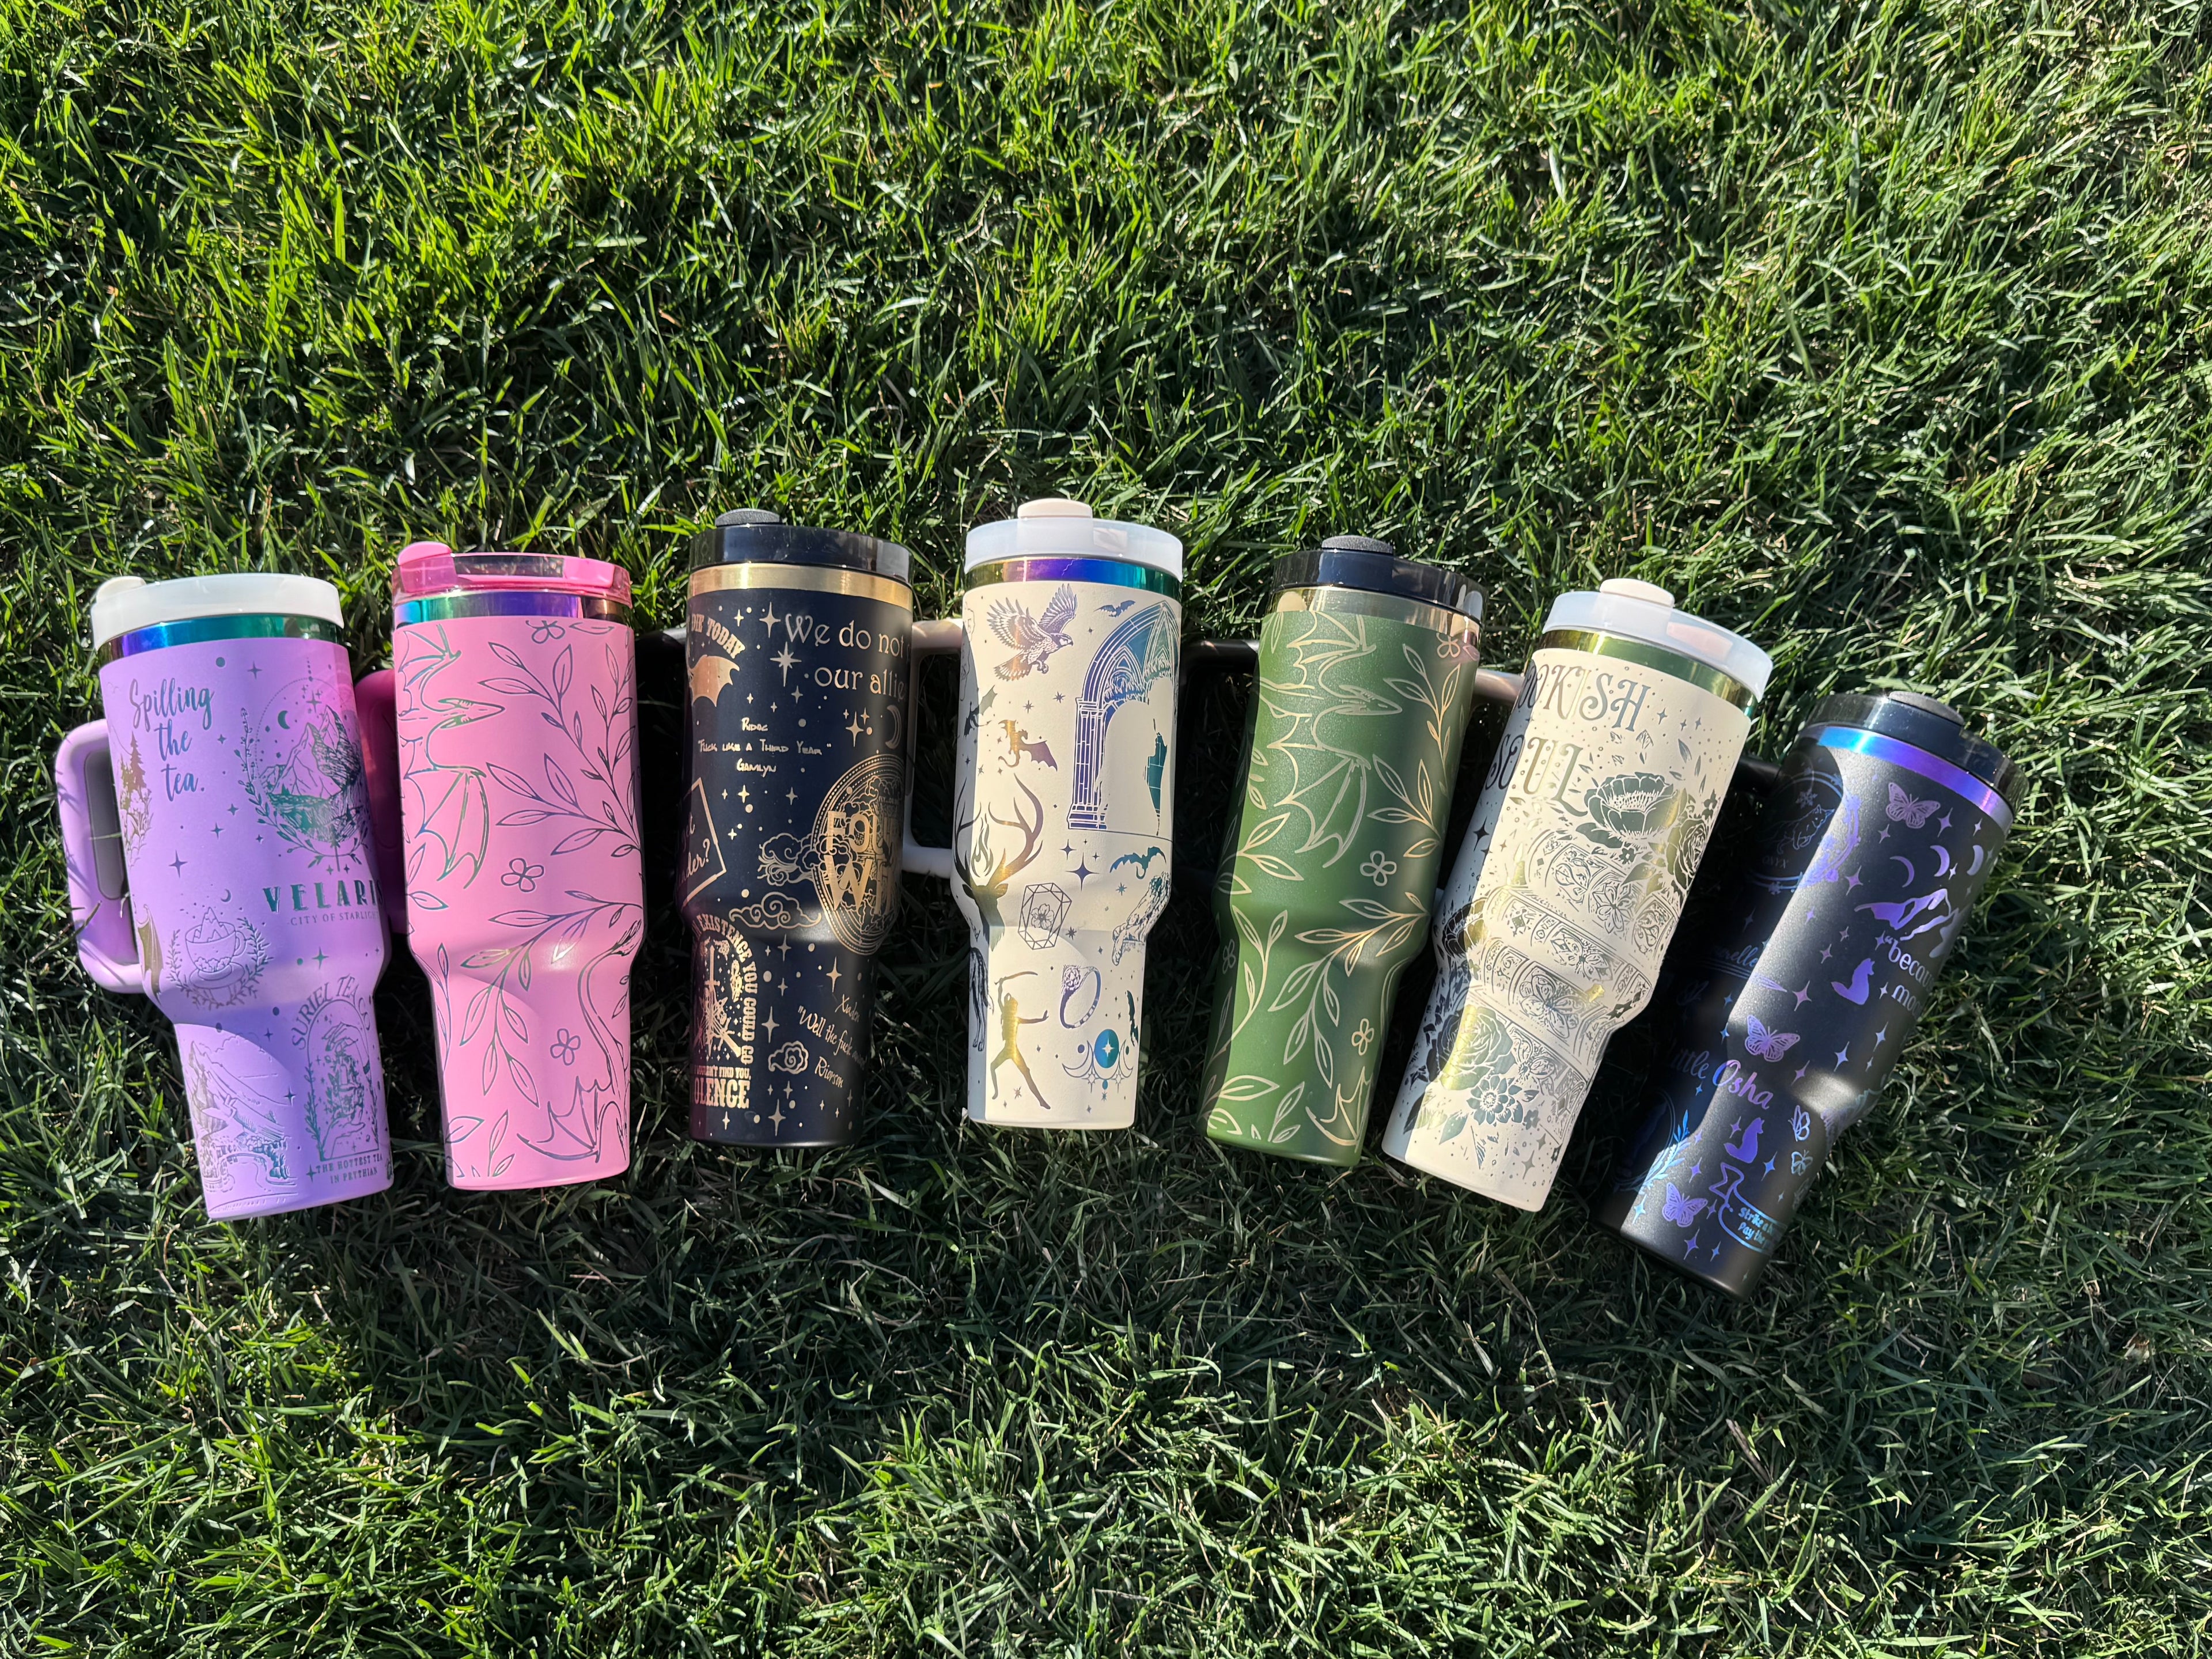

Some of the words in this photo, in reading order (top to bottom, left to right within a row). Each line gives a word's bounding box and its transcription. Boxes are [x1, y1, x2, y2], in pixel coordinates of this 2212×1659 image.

[691, 613, 704, 633] DIE
[706, 616, 746, 660] TODAY
[785, 612, 831, 647] We
[838, 619, 872, 650] do
[878, 632, 904, 659] not
[814, 666, 863, 691] our
[869, 668, 907, 702] allie
[1517, 663, 1652, 732] OOKISH
[129, 677, 215, 733] Spilling
[153, 718, 192, 762] the
[160, 763, 205, 802] tea.
[1484, 734, 1588, 817] SOUL
[262, 879, 384, 913] VELARIS
[290, 915, 318, 926] CITY
[322, 913, 335, 922] OF
[697, 914, 753, 963] EXISTENCE
[742, 960, 759, 995] YOU
[1884, 935, 1934, 993] "becau
[290, 981, 334, 1051] SURIEL
[335, 972, 360, 1007] TEA
[835, 993, 860, 1023] Xaden
[1891, 984, 1923, 1018] moo
[741, 997, 757, 1042] COULD
[740, 1044, 755, 1066] GO
[825, 1024, 838, 1045] the
[833, 1029, 853, 1056] fuck
[719, 1066, 734, 1078] FIND
[735, 1066, 752, 1081] YOU,
[814, 1055, 844, 1088] Riorson
[1668, 1043, 1710, 1080] ittle
[1711, 1059, 1774, 1110] Osha
[694, 1077, 751, 1109] OLENCE
[316, 1163, 334, 1175] THE
[336, 1155, 371, 1170] HOTTEST
[330, 1175, 339, 1184] IN
[343, 1166, 378, 1181] PRYTHIAN
[1737, 1207, 1764, 1228] Strike
[1737, 1221, 1755, 1240] Pay
